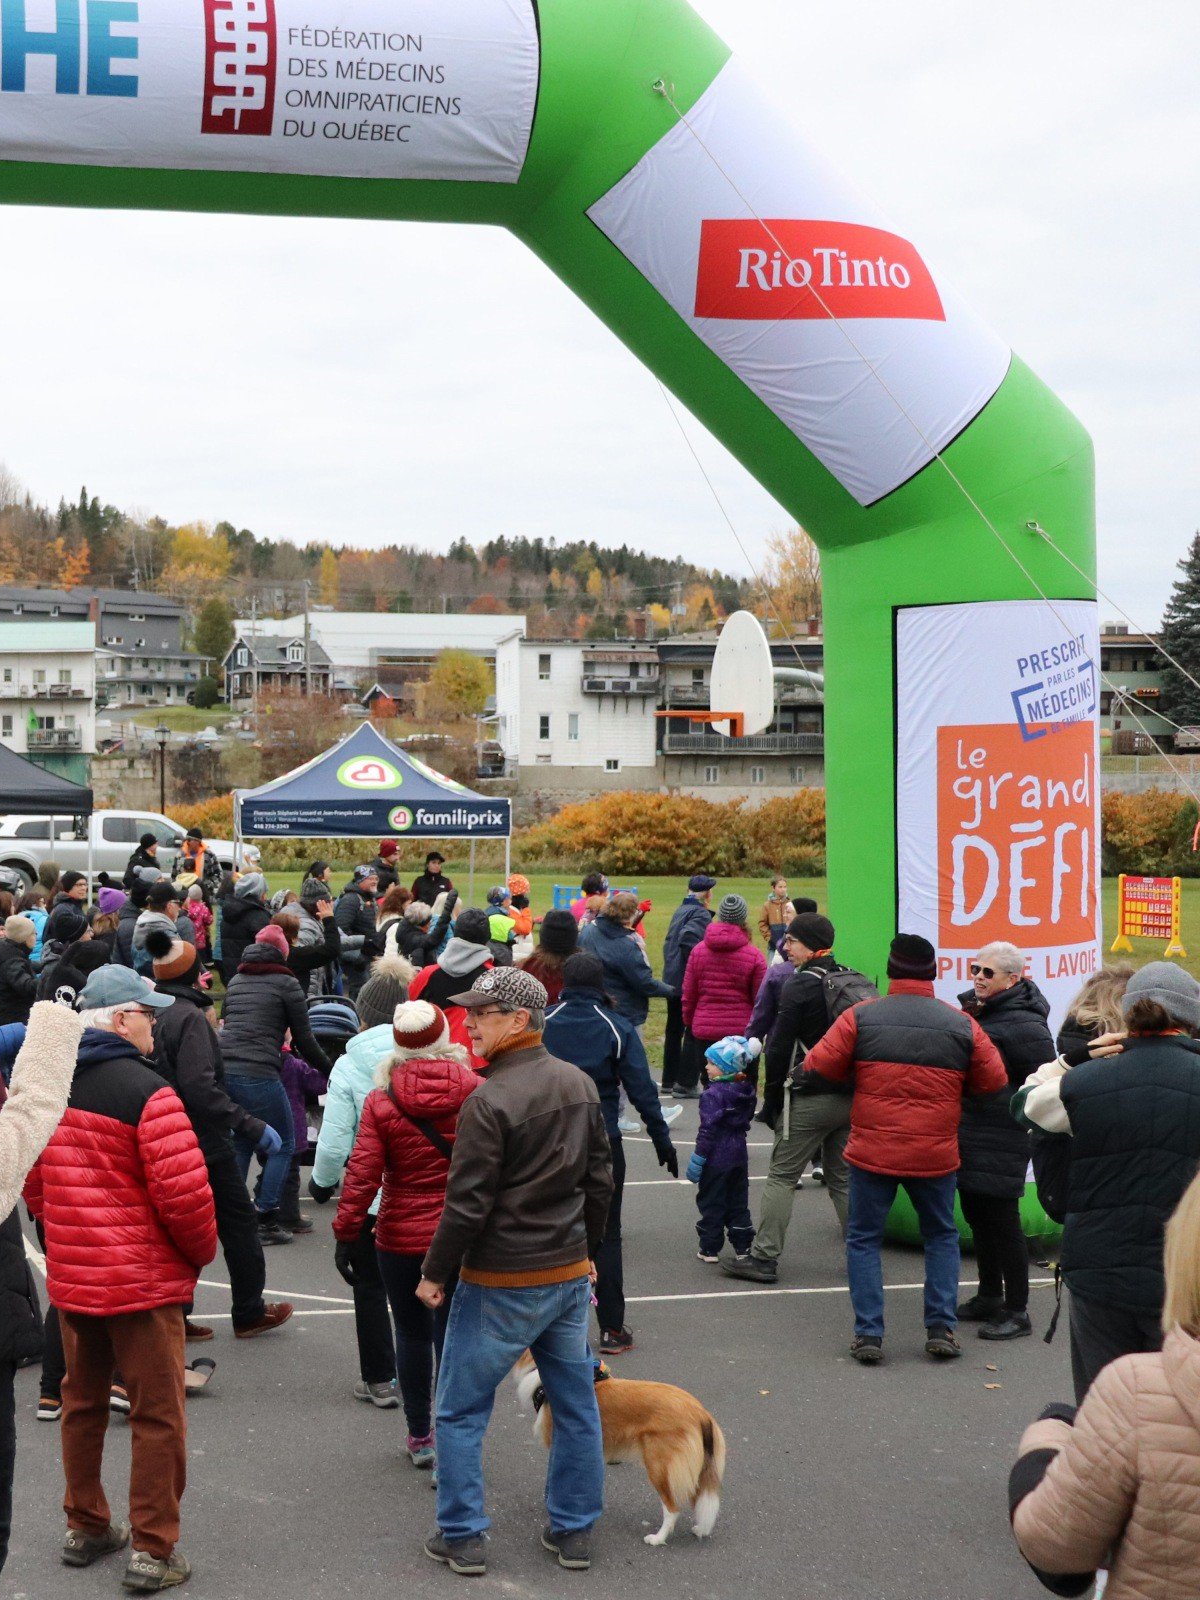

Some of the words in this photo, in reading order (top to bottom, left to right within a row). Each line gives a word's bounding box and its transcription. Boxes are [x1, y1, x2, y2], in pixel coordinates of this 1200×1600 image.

[287, 25, 423, 51] FÉDÉRATION
[287, 58, 328, 78] DES
[335, 58, 446, 84] MÉDECINS
[285, 89, 461, 116] OMNIPRATICIENS
[283, 119, 316, 138] DU
[322, 120, 412, 143] QUÉBEC
[1016, 634, 1085, 678] PRESCRIT
[1047, 673, 1062, 688] PAR
[1063, 668, 1076, 681] LES
[1027, 677, 1091, 722] MÉDECINS
[957, 740, 988, 769] le
[951, 753, 1090, 829] grand
[415, 808, 504, 830] familiprix
[937, 956, 1033, 981] PIEE
[1045, 949, 1097, 979] LAVOIE
[132, 1561, 159, 1574] ecco
